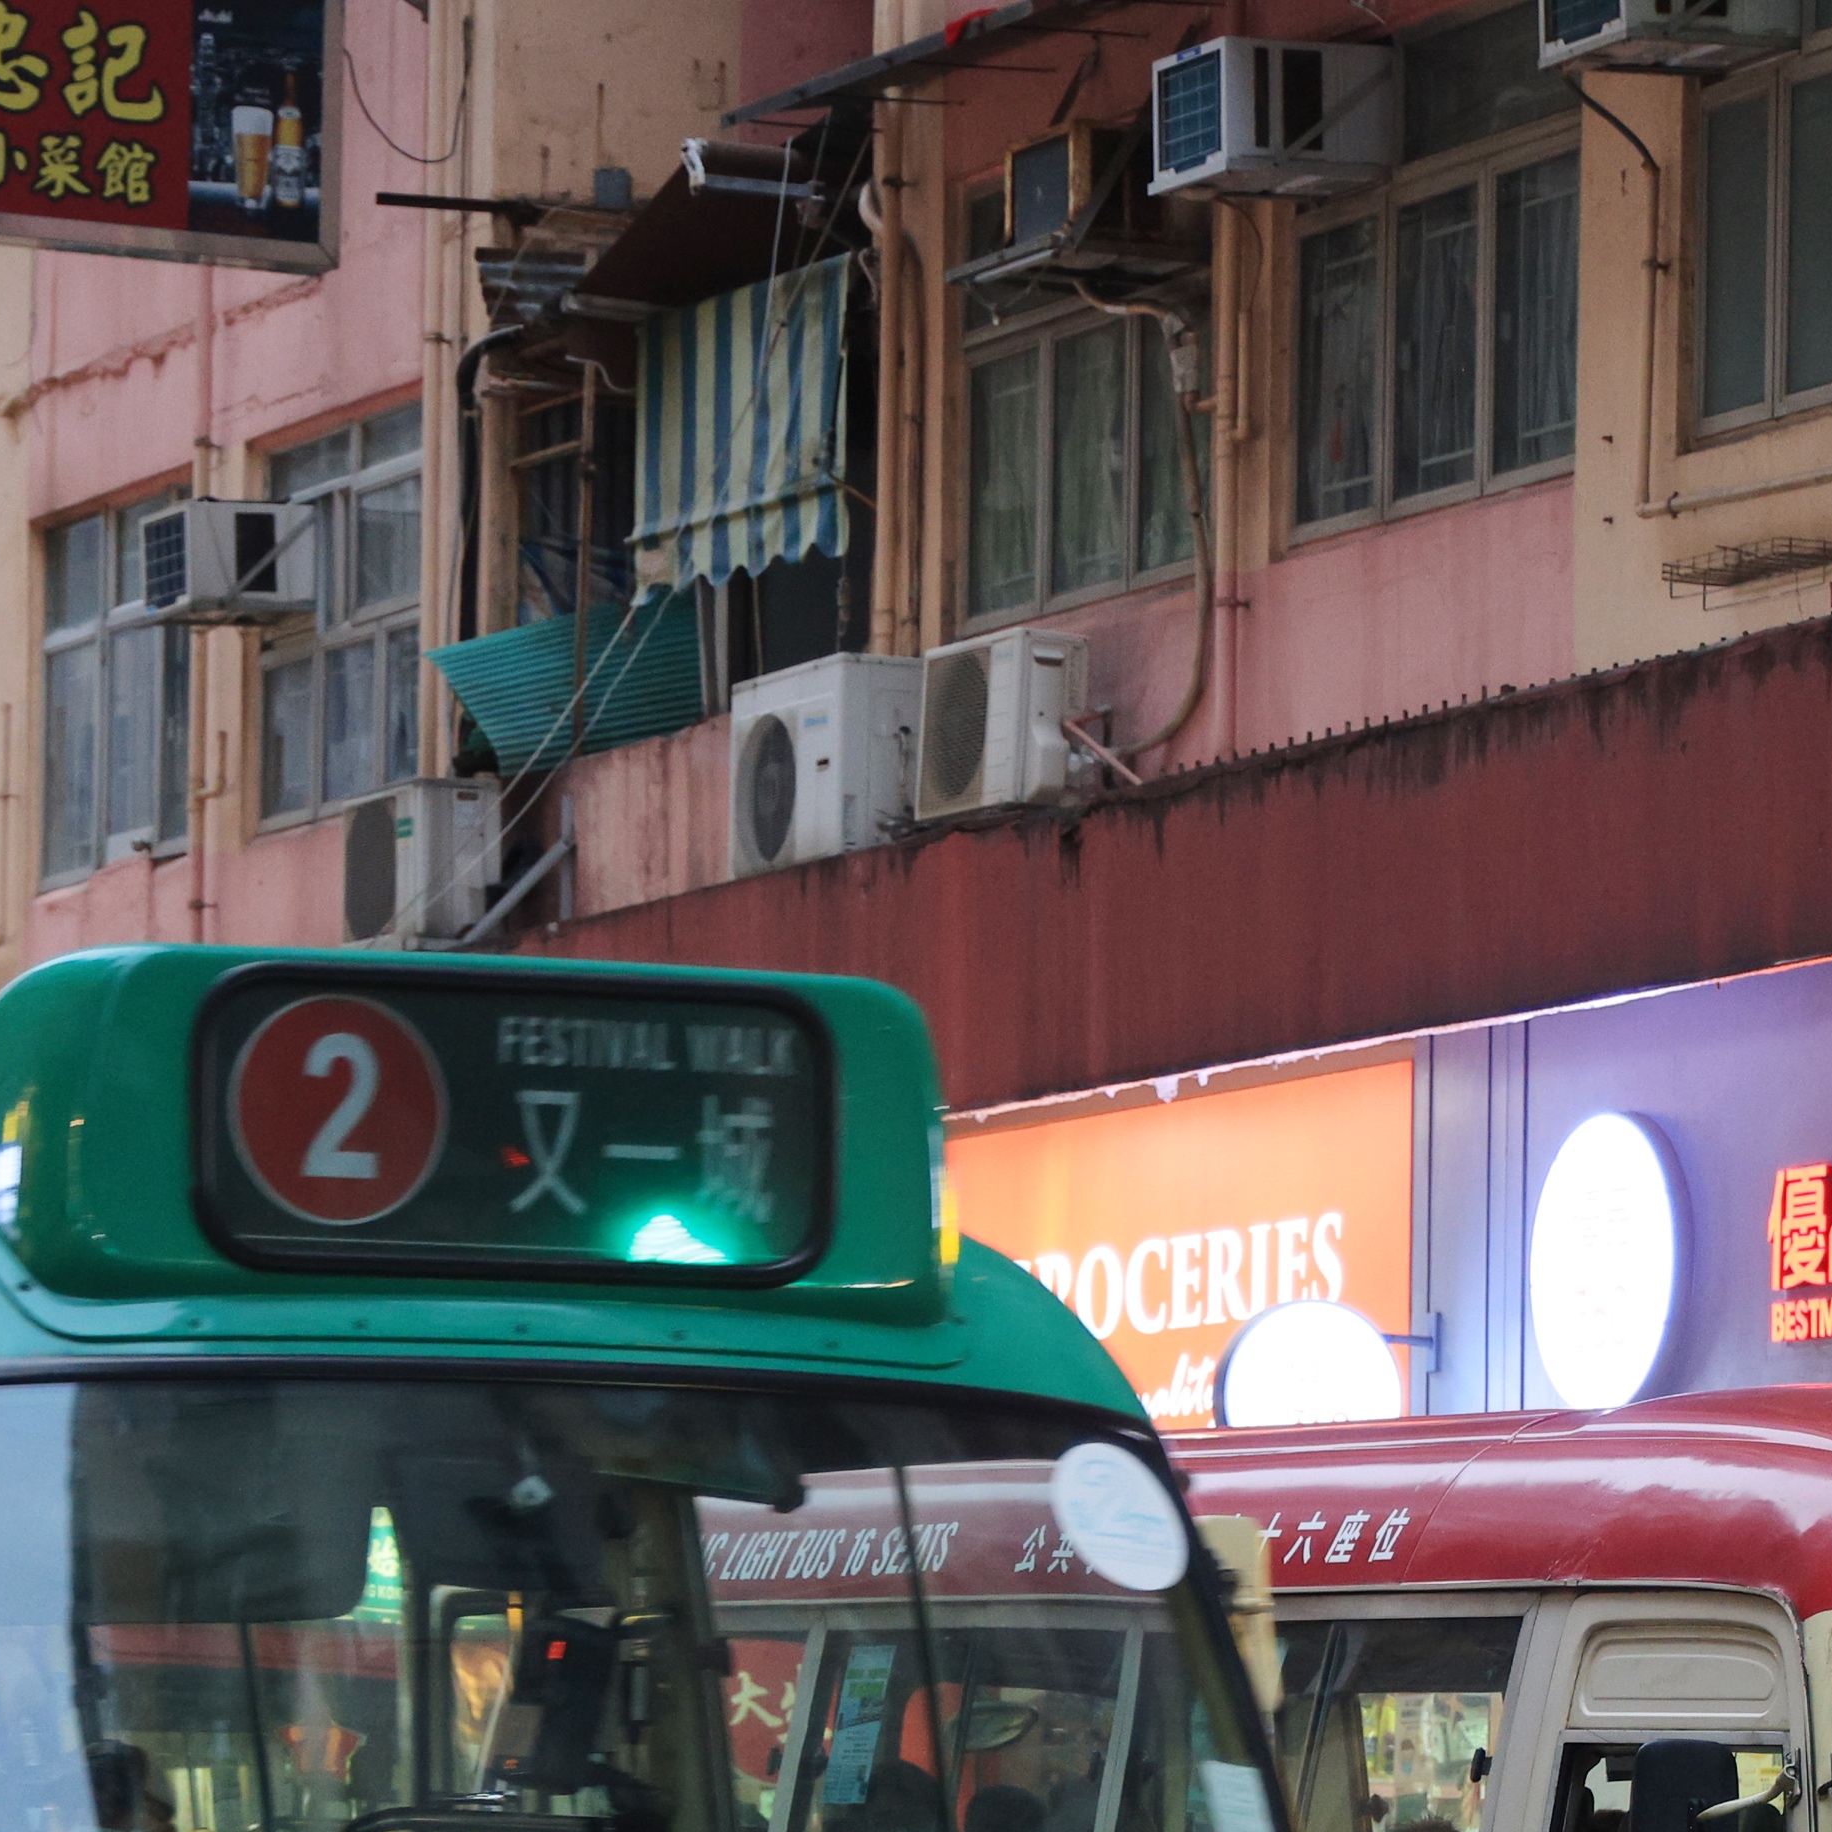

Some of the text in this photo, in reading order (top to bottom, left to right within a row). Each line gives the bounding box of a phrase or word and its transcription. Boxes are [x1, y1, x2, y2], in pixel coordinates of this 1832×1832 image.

[497, 1015, 798, 1076] FESTIVAL WALK
[300, 1032, 381, 1180] 2
[718, 1531, 800, 1580] LIGHT
[785, 1531, 847, 1580] BUS
[838, 1529, 874, 1578] 16
